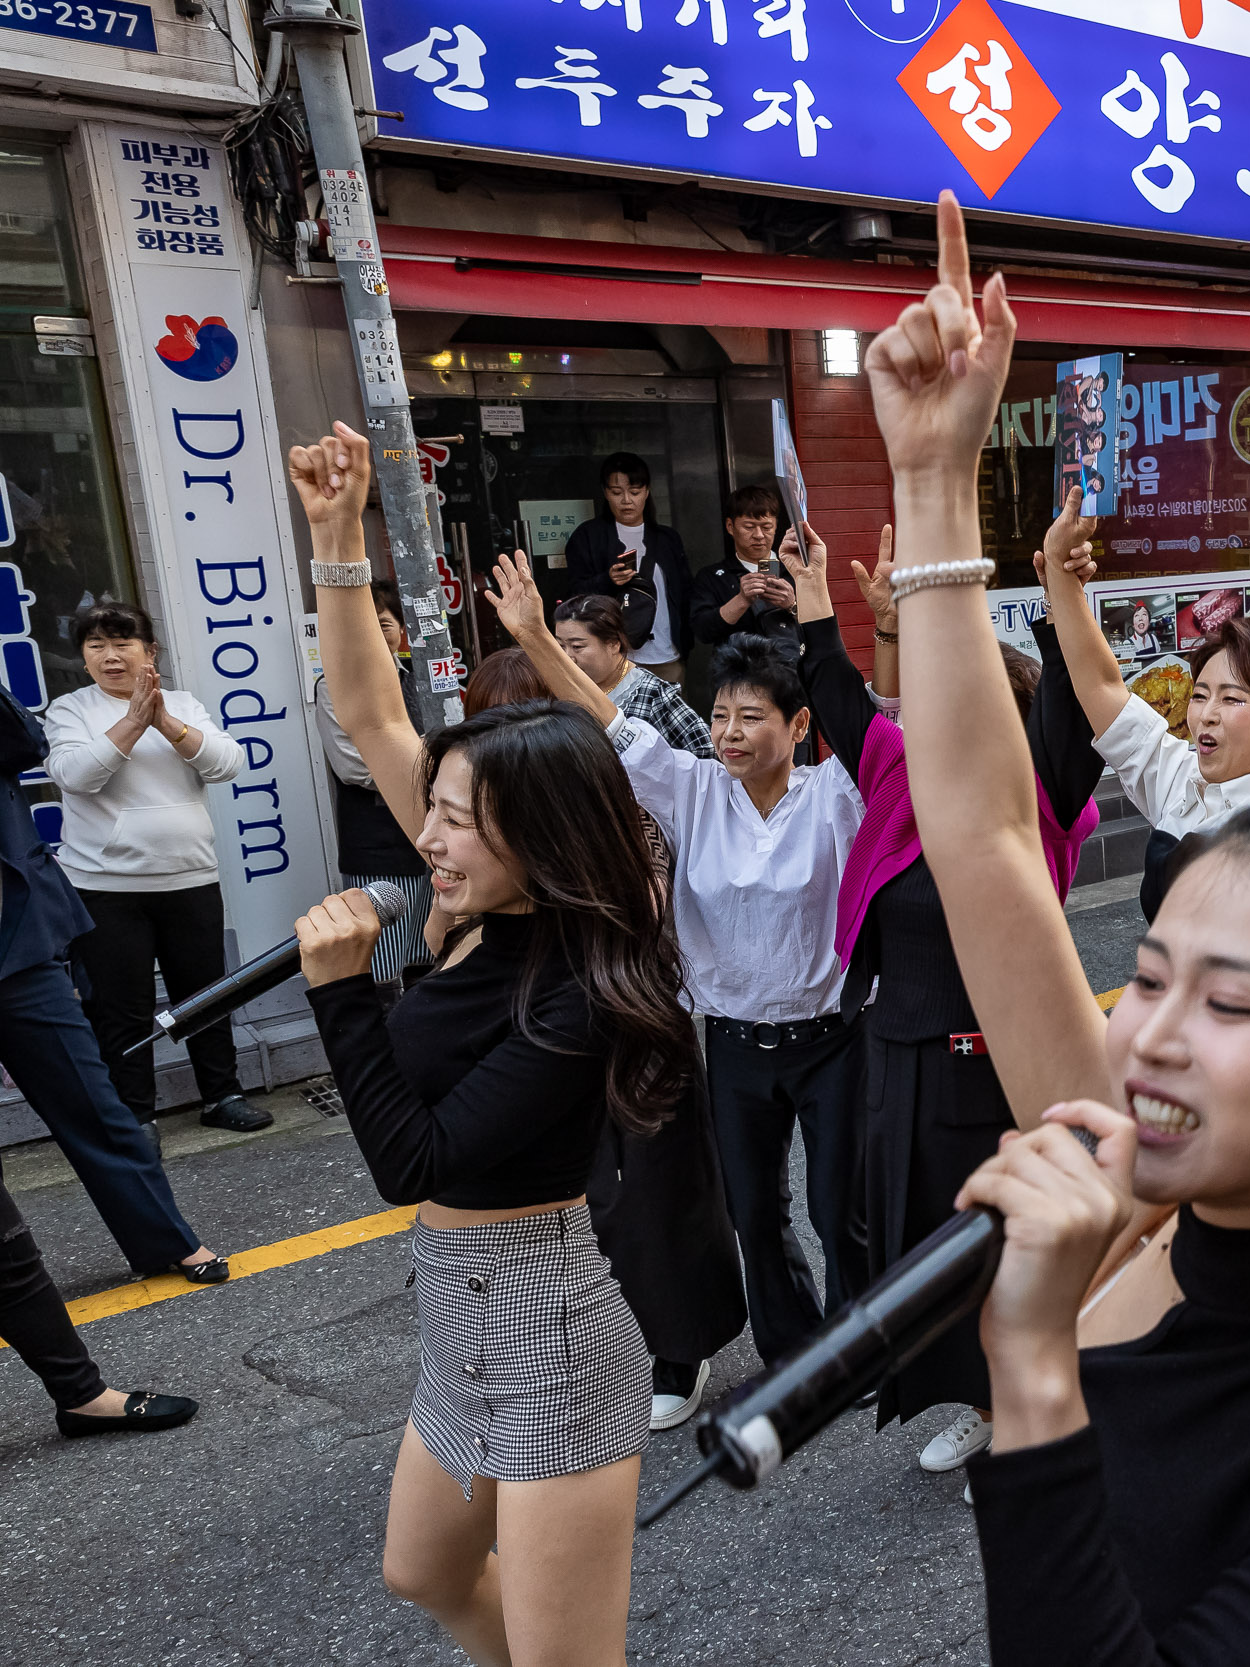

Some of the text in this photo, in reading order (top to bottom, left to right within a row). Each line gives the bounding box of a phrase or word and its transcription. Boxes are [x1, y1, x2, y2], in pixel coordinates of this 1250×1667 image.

[383, 24, 833, 158] 선두주자
[926, 40, 1012, 152] 성
[120, 138, 211, 170] 피부과
[140, 170, 201, 198] 전용
[331, 192, 359, 203] 402
[130, 198, 221, 228] 기능성
[135, 227, 225, 256] 화장품
[359, 264, 387, 278] 이삿짐
[171, 407, 290, 884] Dr. Bioderm
